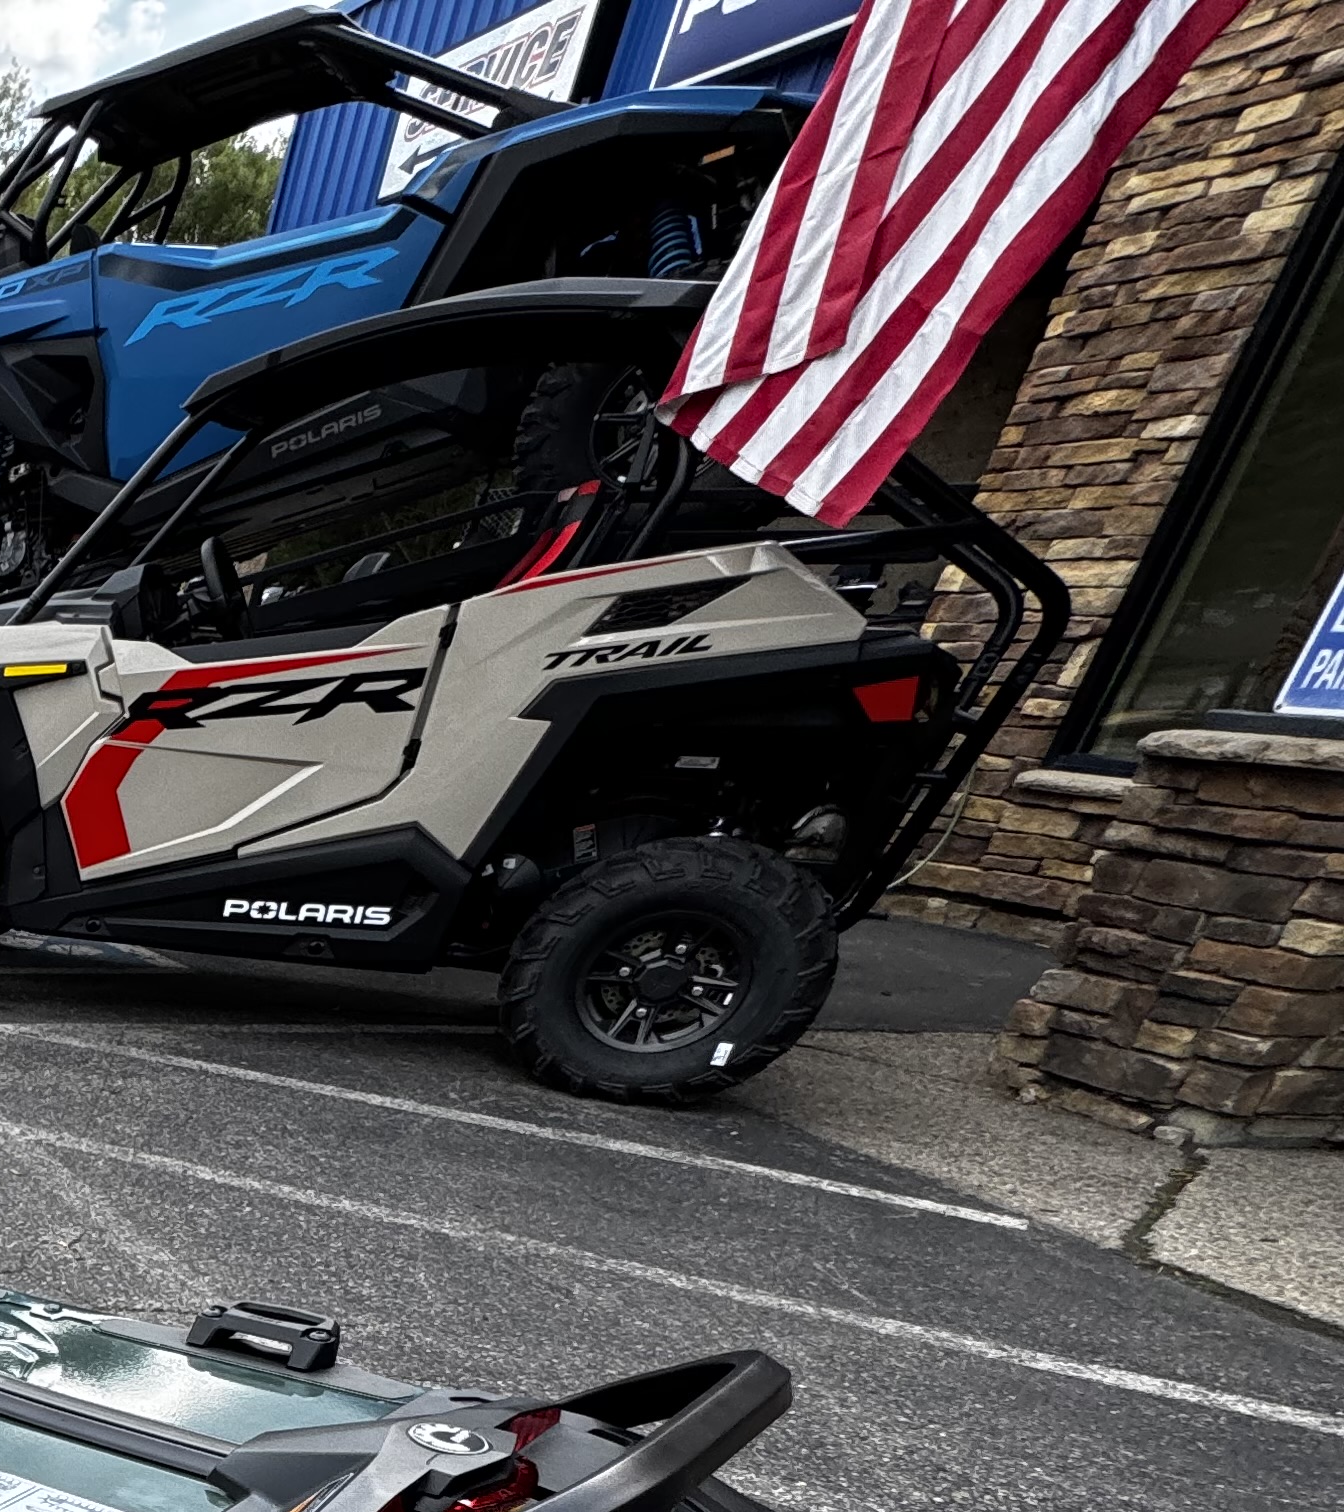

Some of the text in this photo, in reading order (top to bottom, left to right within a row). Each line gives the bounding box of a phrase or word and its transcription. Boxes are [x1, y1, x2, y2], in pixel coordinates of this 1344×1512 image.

[27, 264, 85, 290] XP
[123, 246, 400, 347] RZR
[271, 404, 382, 458] POLARIS
[542, 633, 713, 671] TRAIL
[109, 667, 428, 738] RZR
[223, 899, 392, 925] POLARIS
